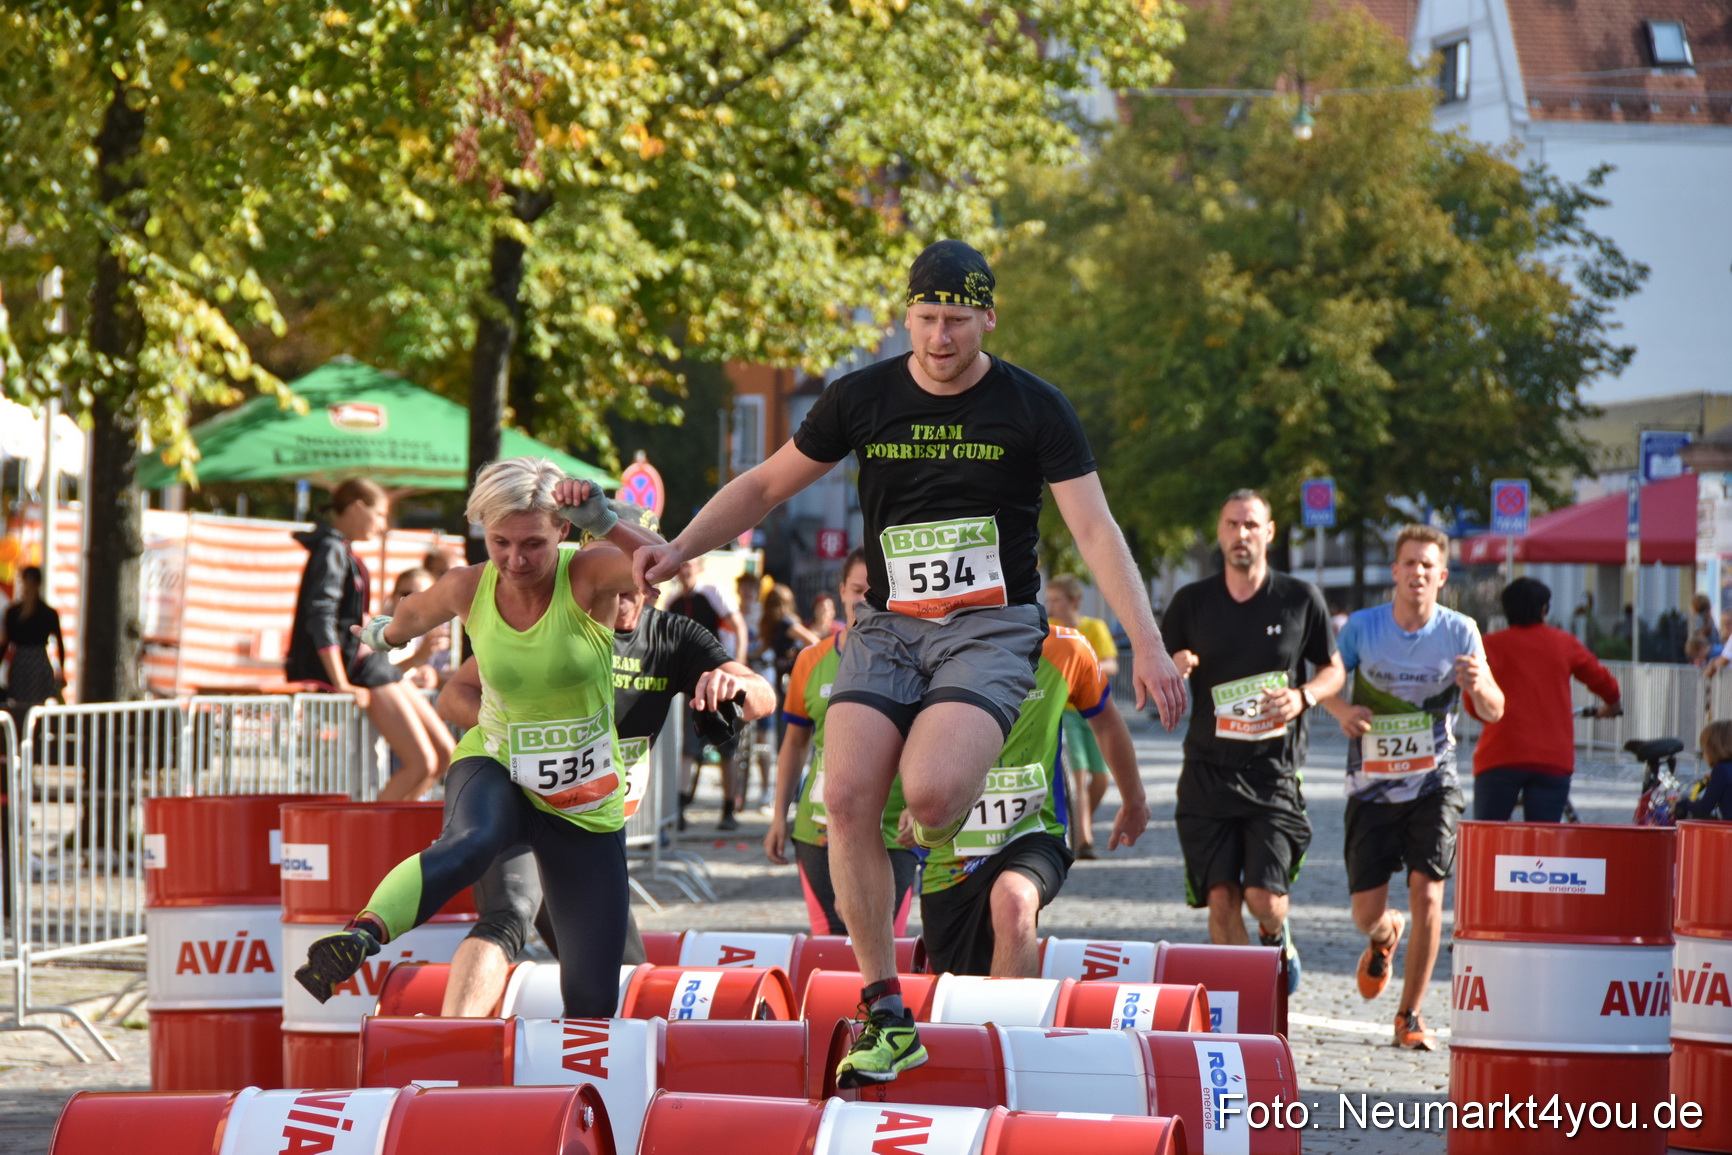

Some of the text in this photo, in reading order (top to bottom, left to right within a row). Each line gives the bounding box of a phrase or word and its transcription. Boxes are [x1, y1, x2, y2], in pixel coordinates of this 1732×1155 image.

[911, 424, 963, 440] TEAM
[865, 443, 1005, 460] FORREST GUMP
[888, 521, 988, 554] BOCK
[909, 556, 976, 594] 534
[518, 719, 605, 750] BOCK
[1230, 721, 1275, 732] FLORIAN
[1377, 736, 1419, 757] 524
[538, 747, 595, 790] 535
[1388, 762, 1411, 772] LEO
[974, 797, 1027, 825] 113
[1548, 883, 1587, 893] energie
[1203, 1087, 1213, 1130] energie
